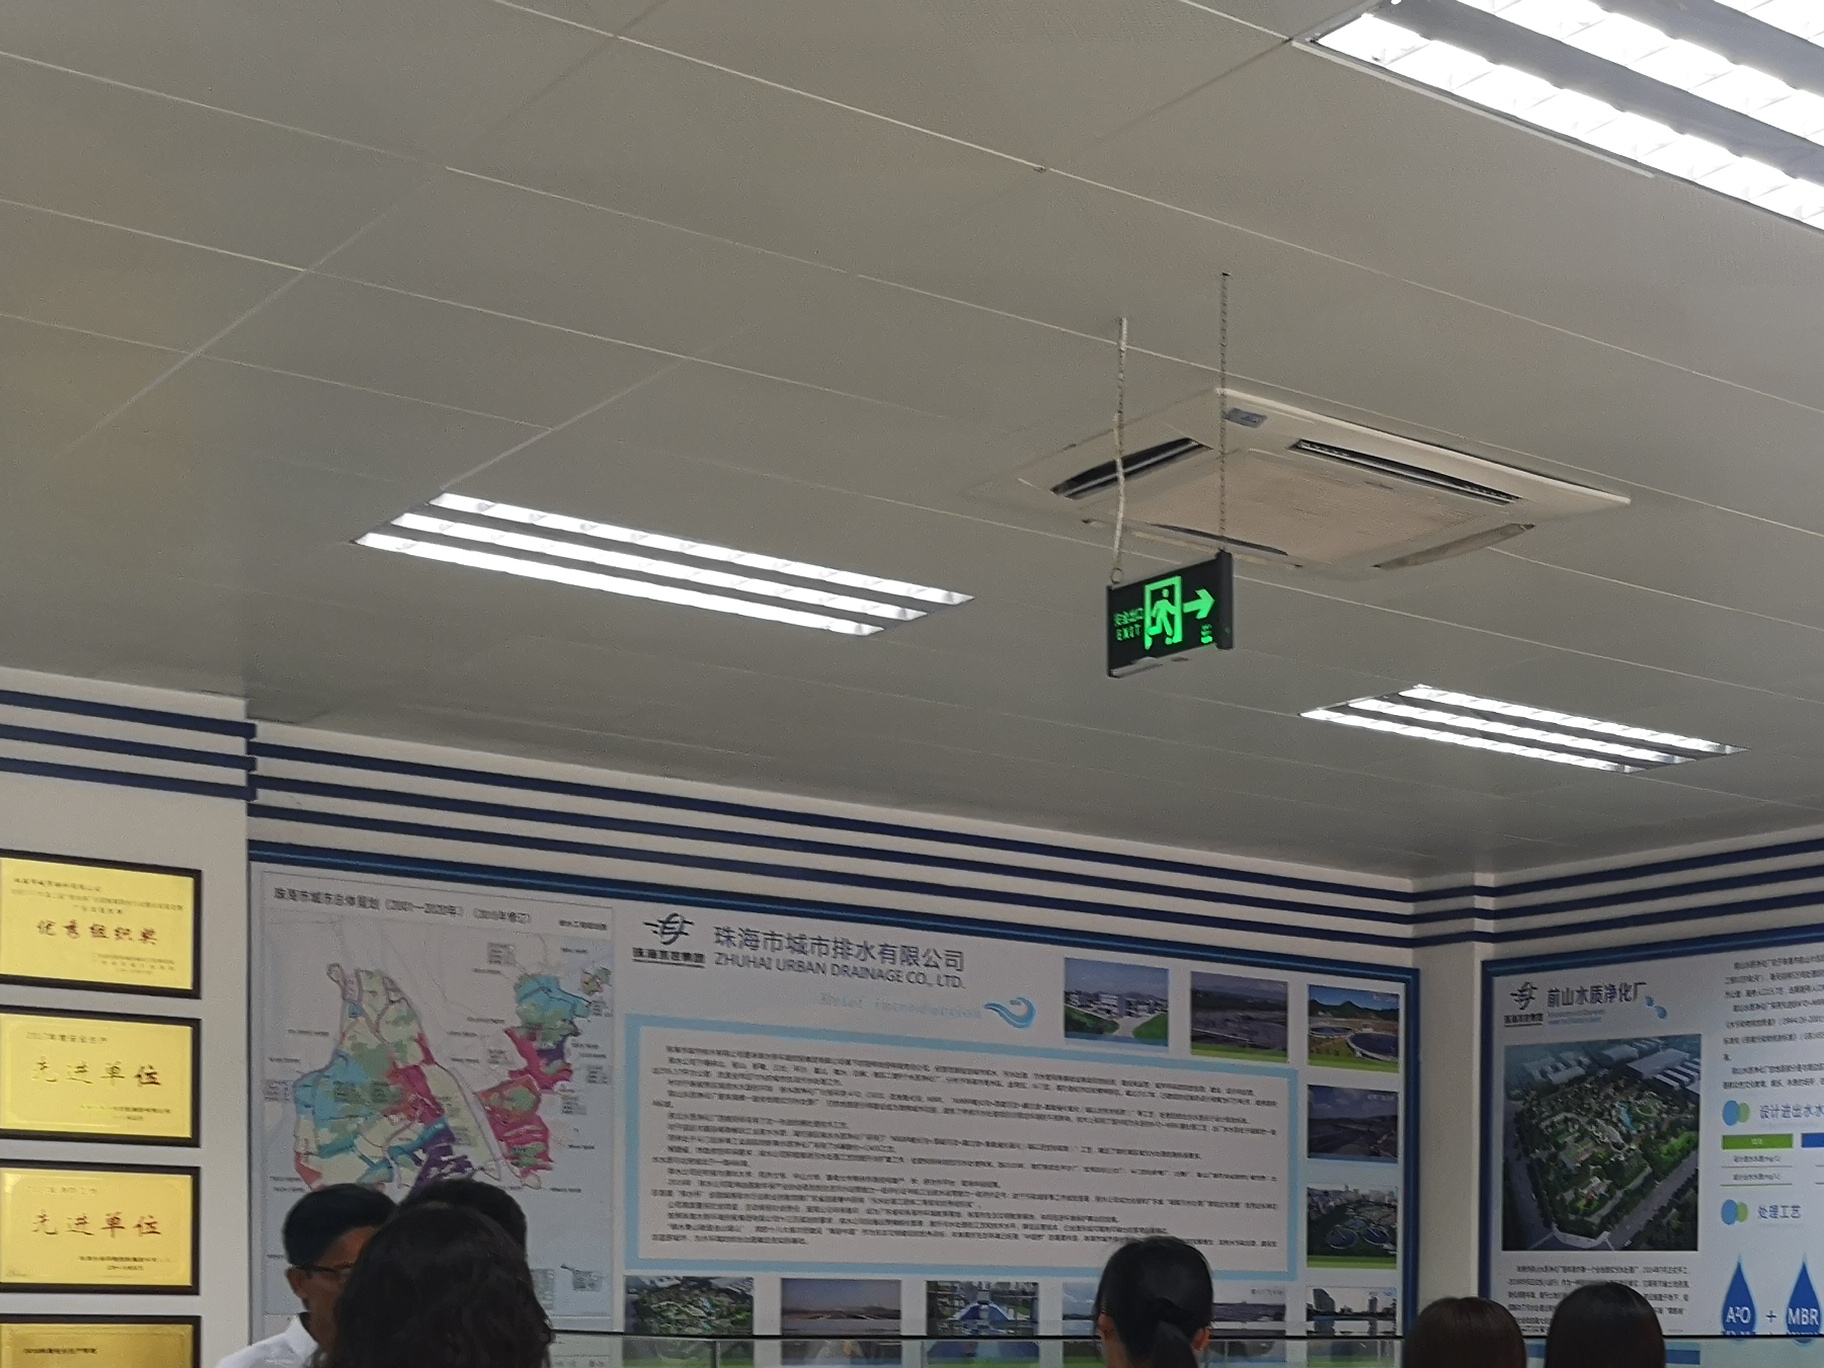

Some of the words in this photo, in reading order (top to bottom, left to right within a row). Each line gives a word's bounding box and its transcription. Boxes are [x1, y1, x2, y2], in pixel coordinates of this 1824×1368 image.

[1116, 623, 1141, 641] EXIT
[714, 926, 966, 972] 珠海市城市排水有限公司
[714, 951, 772, 970] ZHUHAI
[776, 957, 827, 976] URBAN
[830, 963, 903, 984] DRAINAGE
[1547, 982, 1647, 1008] 前山水质净化厂
[32, 1056, 161, 1088] 先进单位
[32, 1208, 161, 1238] 先进单位
[1757, 1204, 1802, 1219] 处理工艺
[1787, 1307, 1820, 1326] MBR
